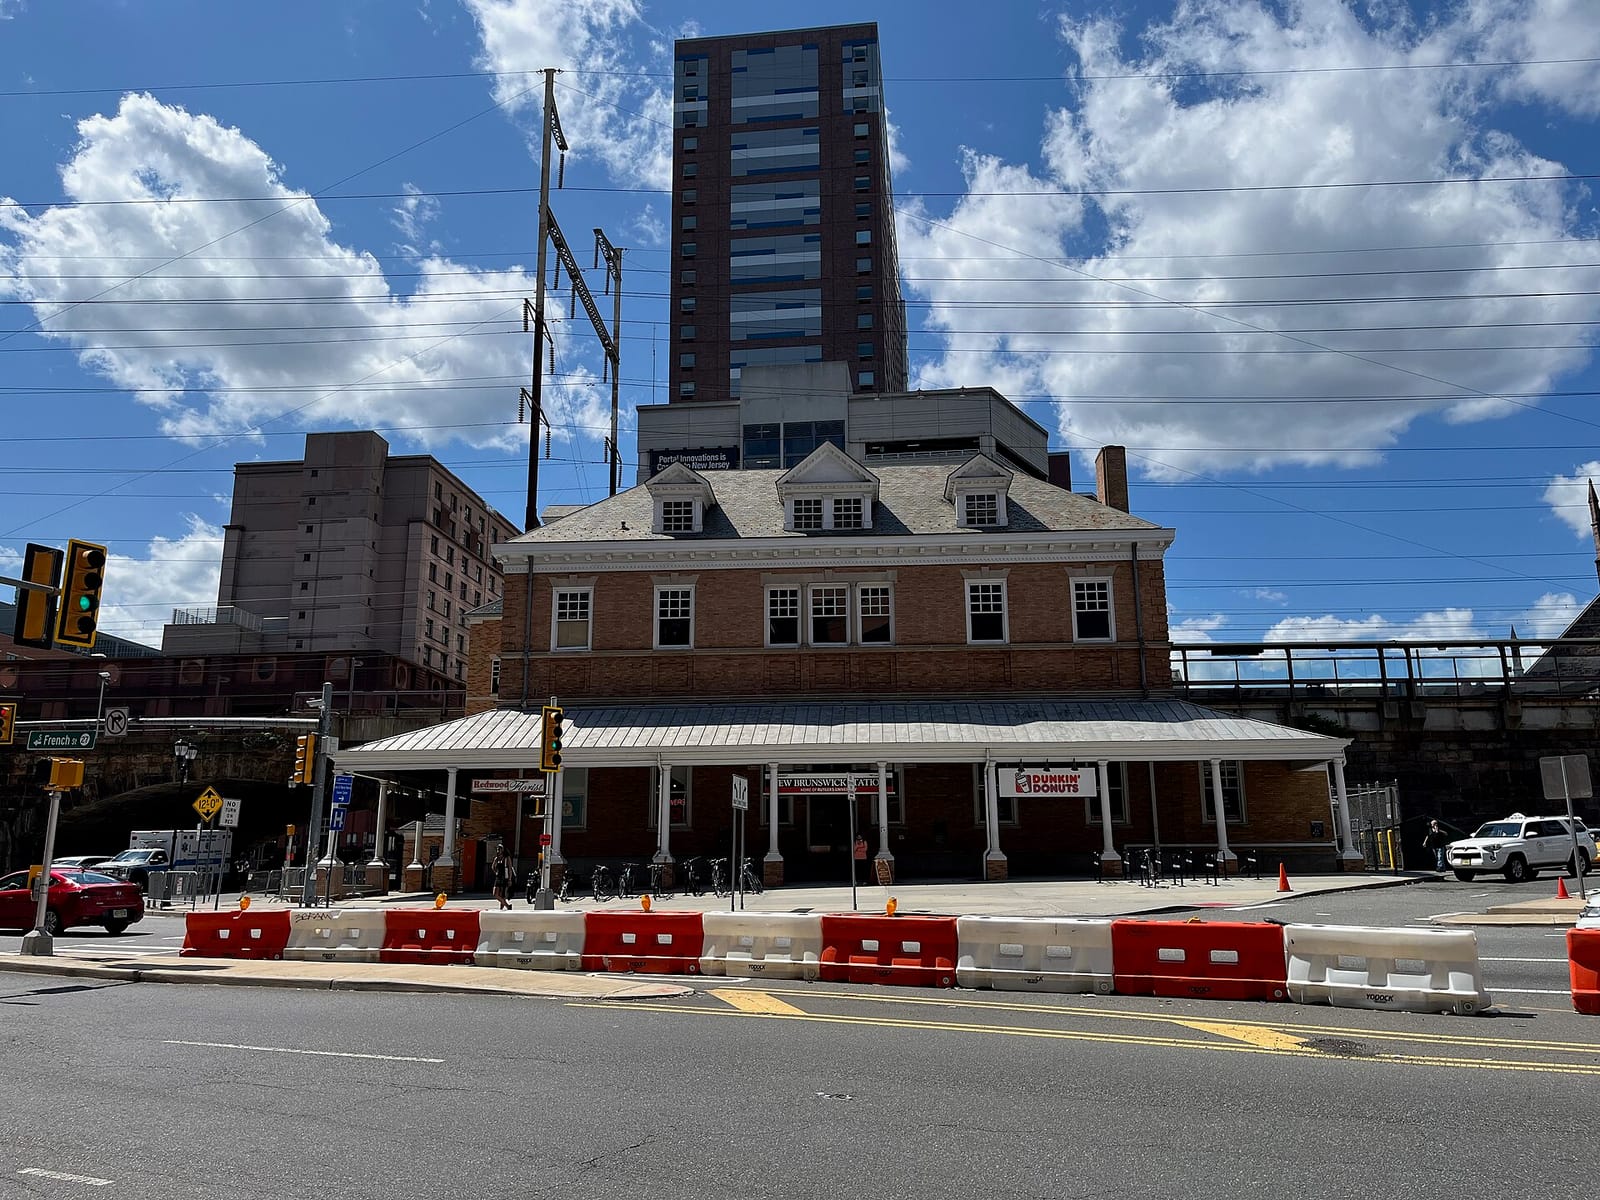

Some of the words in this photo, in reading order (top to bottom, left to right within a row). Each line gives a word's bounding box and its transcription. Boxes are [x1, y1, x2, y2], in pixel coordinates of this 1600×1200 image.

[659, 455, 679, 463] Portal
[680, 453, 719, 462] Innovations
[720, 453, 726, 461] is
[708, 461, 730, 470] Jersey
[43, 733, 71, 746] French
[794, 778, 847, 787] BRUNSWICK
[853, 778, 880, 787] TATIO
[1033, 774, 1080, 783] DUNKIN'
[473, 780, 510, 790] Redwood
[510, 780, 544, 791] Florist
[1033, 784, 1079, 793] DONUTS
[226, 800, 237, 808] NO
[333, 811, 344, 828] H
[1366, 993, 1394, 1002] YODOCK
